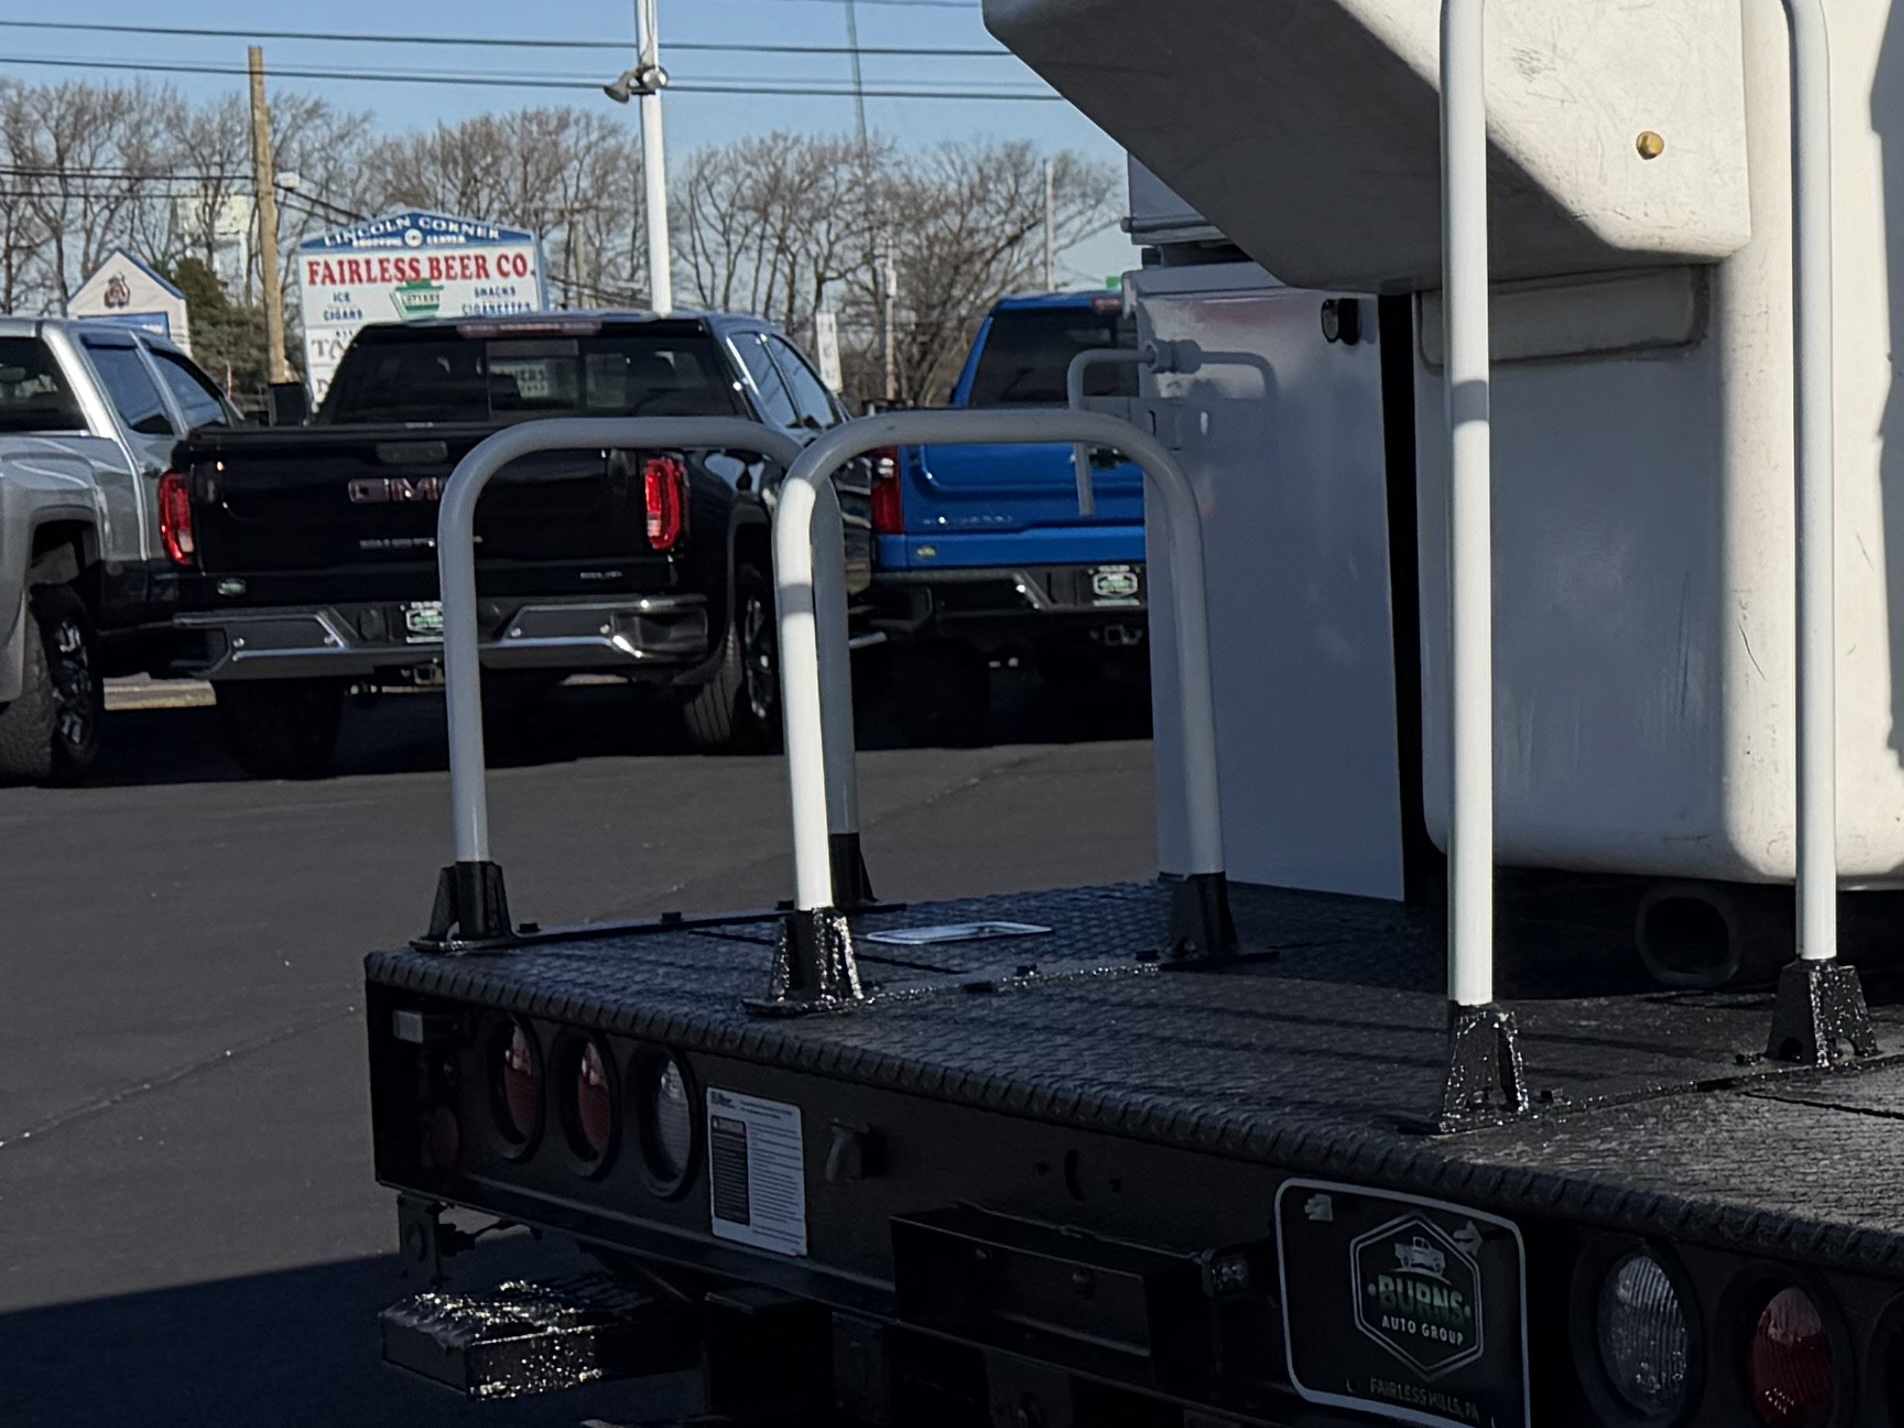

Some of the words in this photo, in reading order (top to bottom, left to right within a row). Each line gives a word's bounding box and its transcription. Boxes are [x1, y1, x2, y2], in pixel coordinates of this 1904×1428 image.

[324, 215, 411, 247] LINCOLN
[419, 216, 499, 240] CORNER
[307, 257, 421, 286] FAIRLESS
[427, 254, 490, 281] BEER
[496, 252, 537, 277] CO.
[348, 477, 447, 503] GM
[1377, 1274, 1466, 1325] BURNS
[1382, 1315, 1416, 1334] AUTO
[1422, 1322, 1464, 1346] GROUP
[1370, 1377, 1427, 1405] FAIRLESS
[1464, 1401, 1480, 1424] PA
